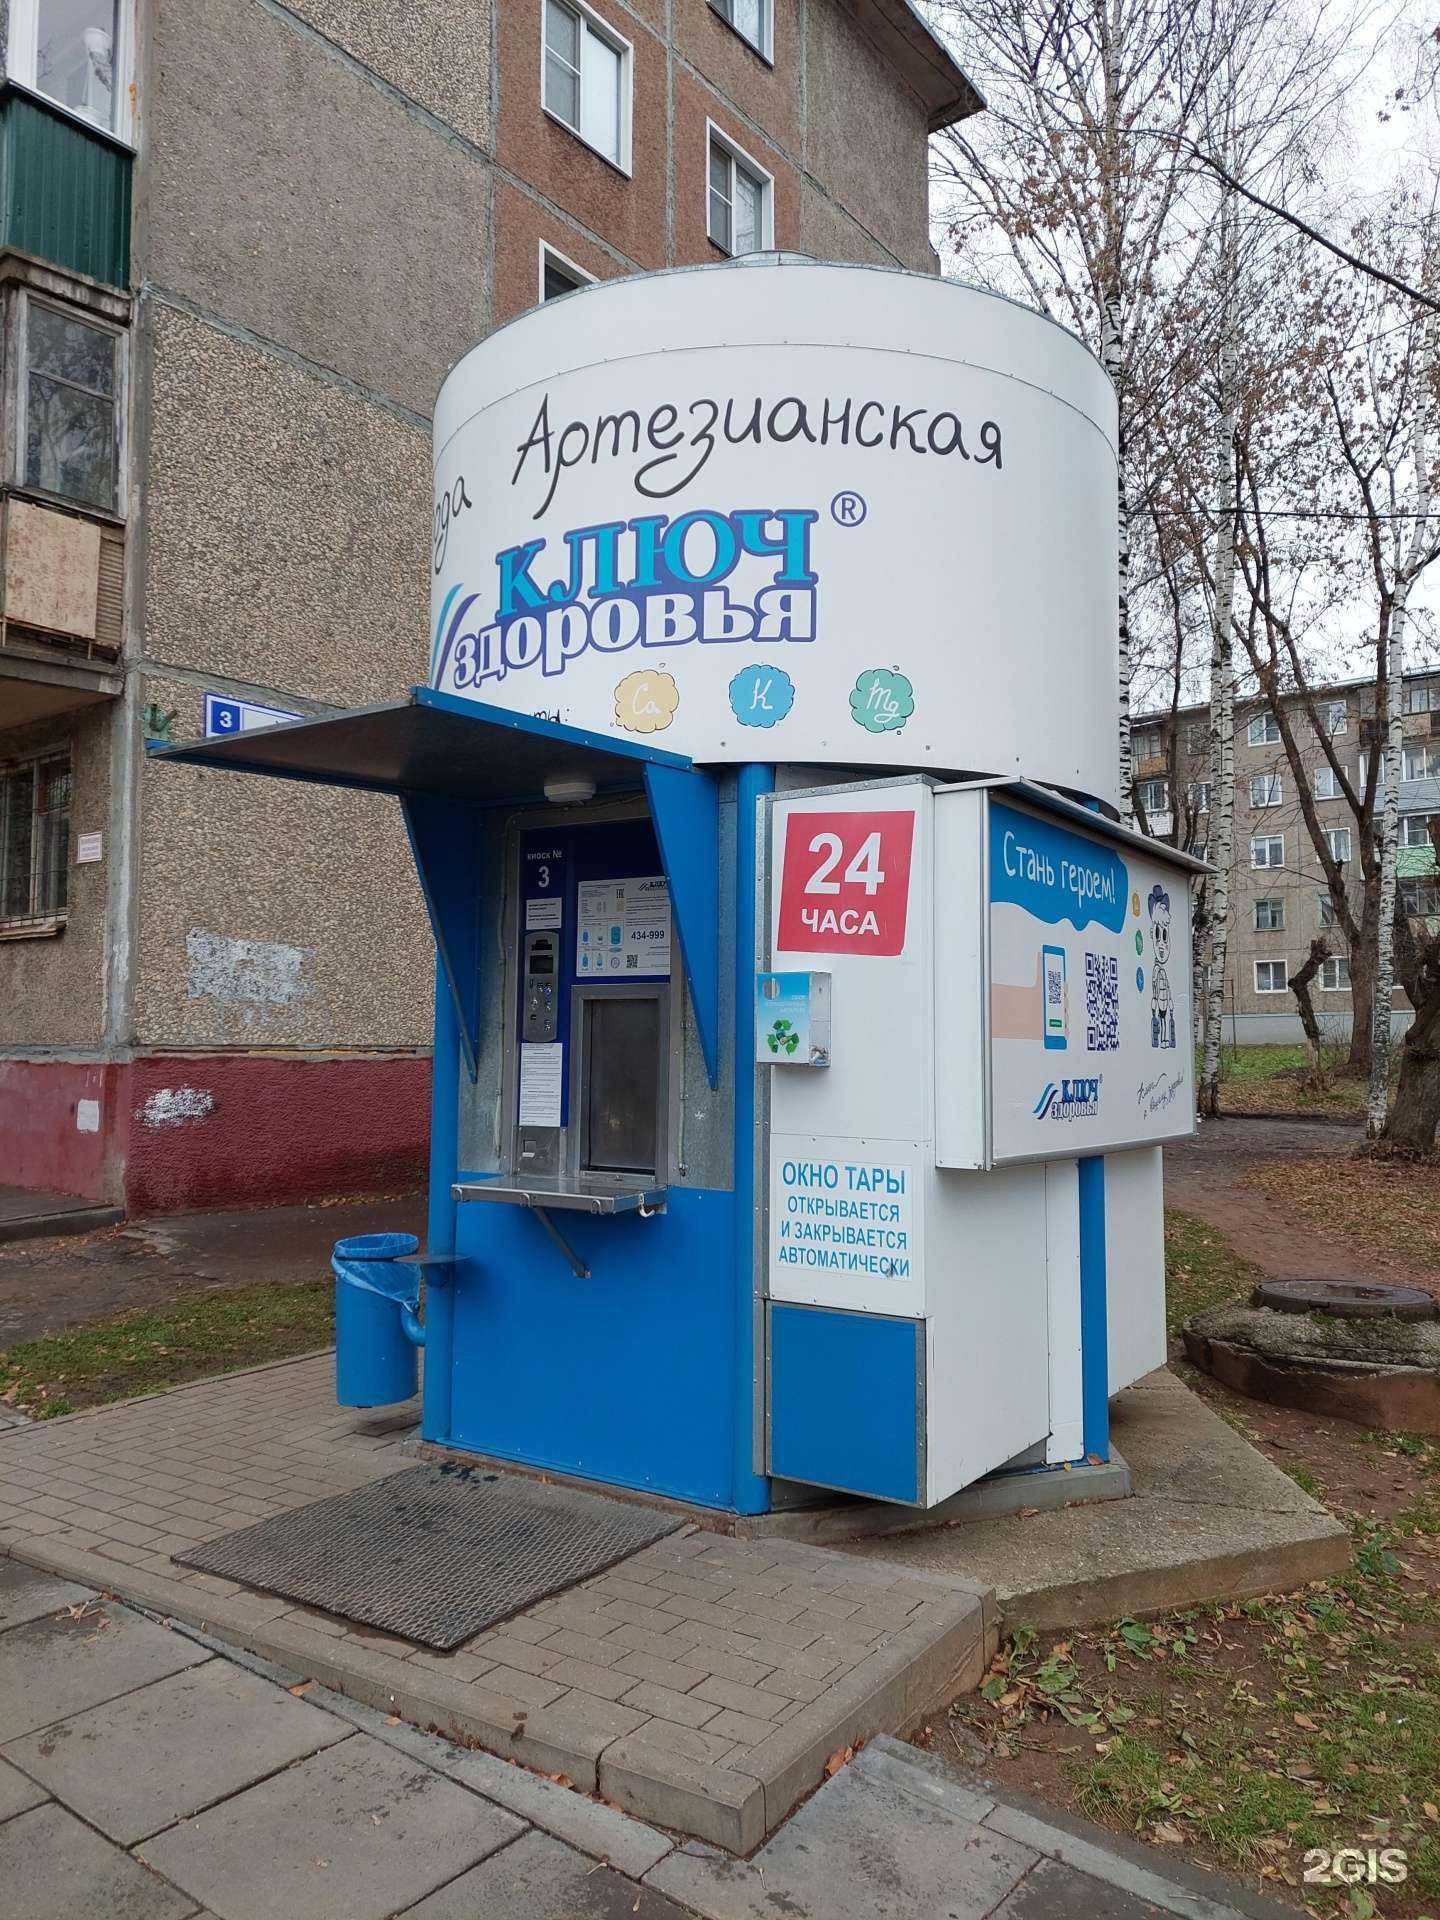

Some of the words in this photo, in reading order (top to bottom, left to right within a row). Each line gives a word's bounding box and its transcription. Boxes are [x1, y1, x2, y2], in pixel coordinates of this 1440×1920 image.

[434, 475, 473, 575] ода
[512, 393, 1003, 519] Артезианская
[495, 508, 820, 623] КЛЮЧ
[632, 682, 663, 715] Ca
[749, 678, 773, 710] K
[865, 678, 900, 723] Mg
[219, 710, 233, 729] 3
[538, 865, 551, 888] 3
[804, 832, 885, 895] 24
[1003, 830, 1055, 887] Стань
[1061, 860, 1117, 909] героем!
[630, 929, 666, 941] 434-999
[801, 908, 880, 936] ЧАСА
[782, 1161, 839, 1189] ОКНО
[845, 1165, 906, 1194] ТАРЫ
[787, 1195, 900, 1223] ОТКРЫВАЕТСЯ
[781, 1220, 791, 1238] И
[794, 1221, 908, 1250] ЗАКРЫВАЕТСЯ
[778, 1245, 910, 1278] АВТОМАТИЧЕСКИ
